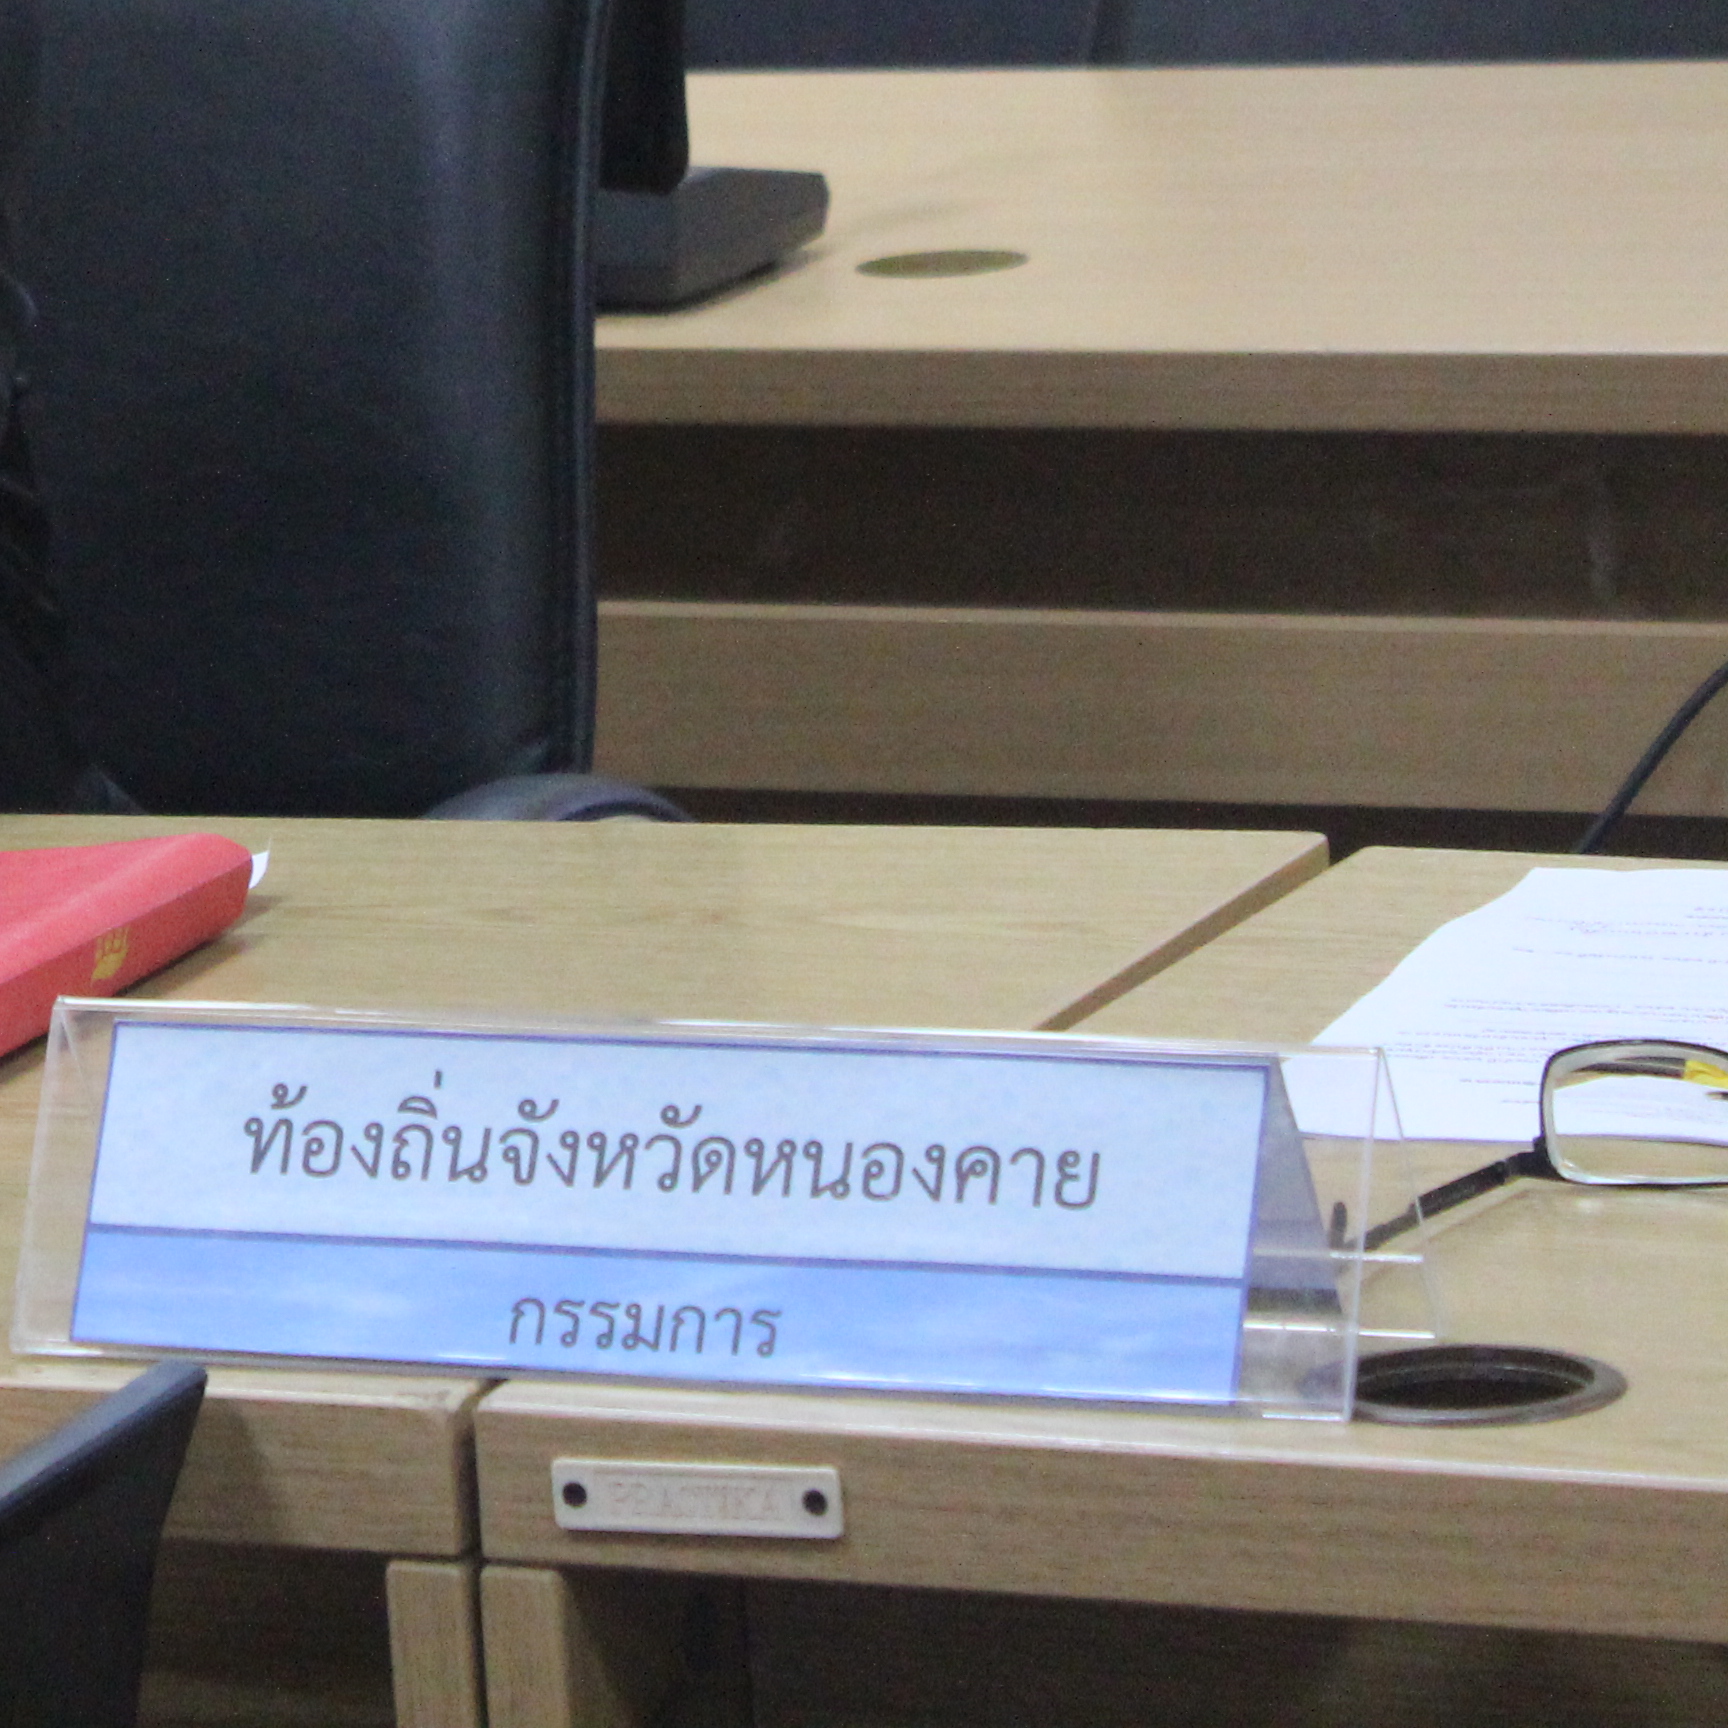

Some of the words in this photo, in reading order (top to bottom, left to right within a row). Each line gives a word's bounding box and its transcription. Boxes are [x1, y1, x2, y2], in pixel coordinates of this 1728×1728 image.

[243, 1069, 1101, 1211] ท้องถิ่นจังหวัดหนองคาย
[508, 1297, 783, 1358] กรรมการ
